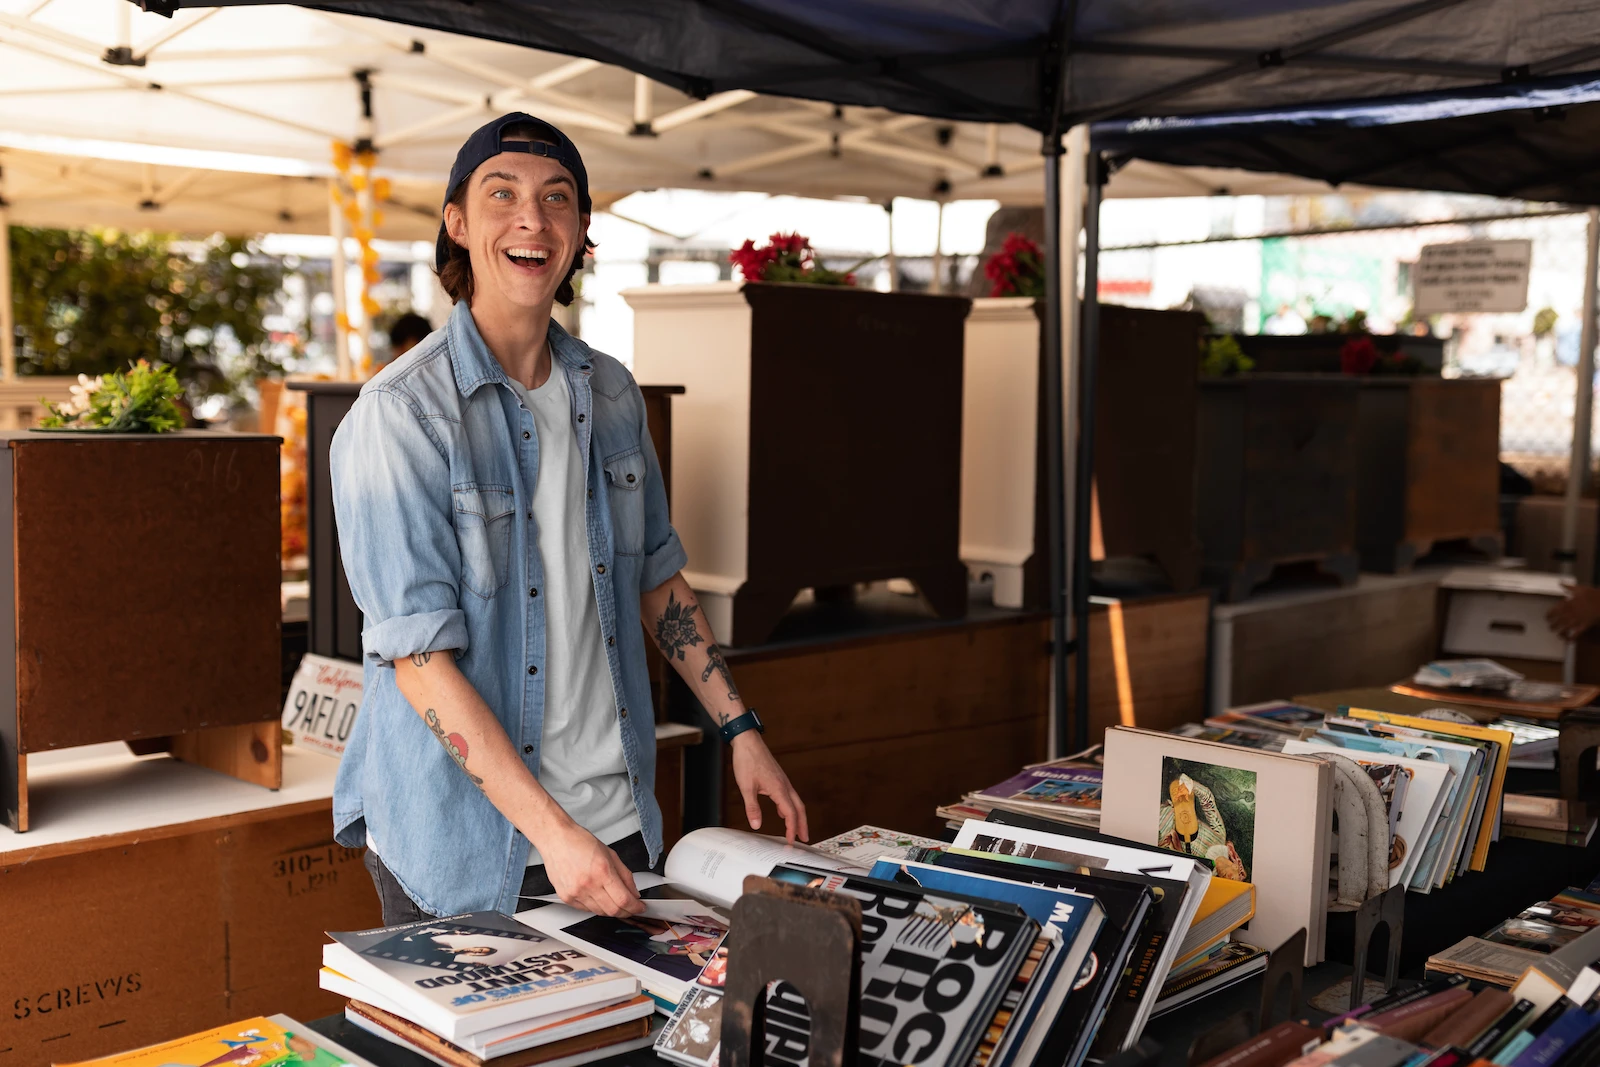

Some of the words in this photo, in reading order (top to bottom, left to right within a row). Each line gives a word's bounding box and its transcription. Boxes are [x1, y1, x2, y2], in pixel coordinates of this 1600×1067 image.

[1031, 770, 1072, 780] Walt
[1073, 774, 1104, 783] Dis
[414, 949, 588, 989] EASTWOOD
[466, 964, 574, 993] CLINT
[565, 966, 620, 981] THE
[14, 972, 141, 1019] SCREWS
[485, 976, 570, 998] FILMS
[450, 994, 487, 1006] OF
